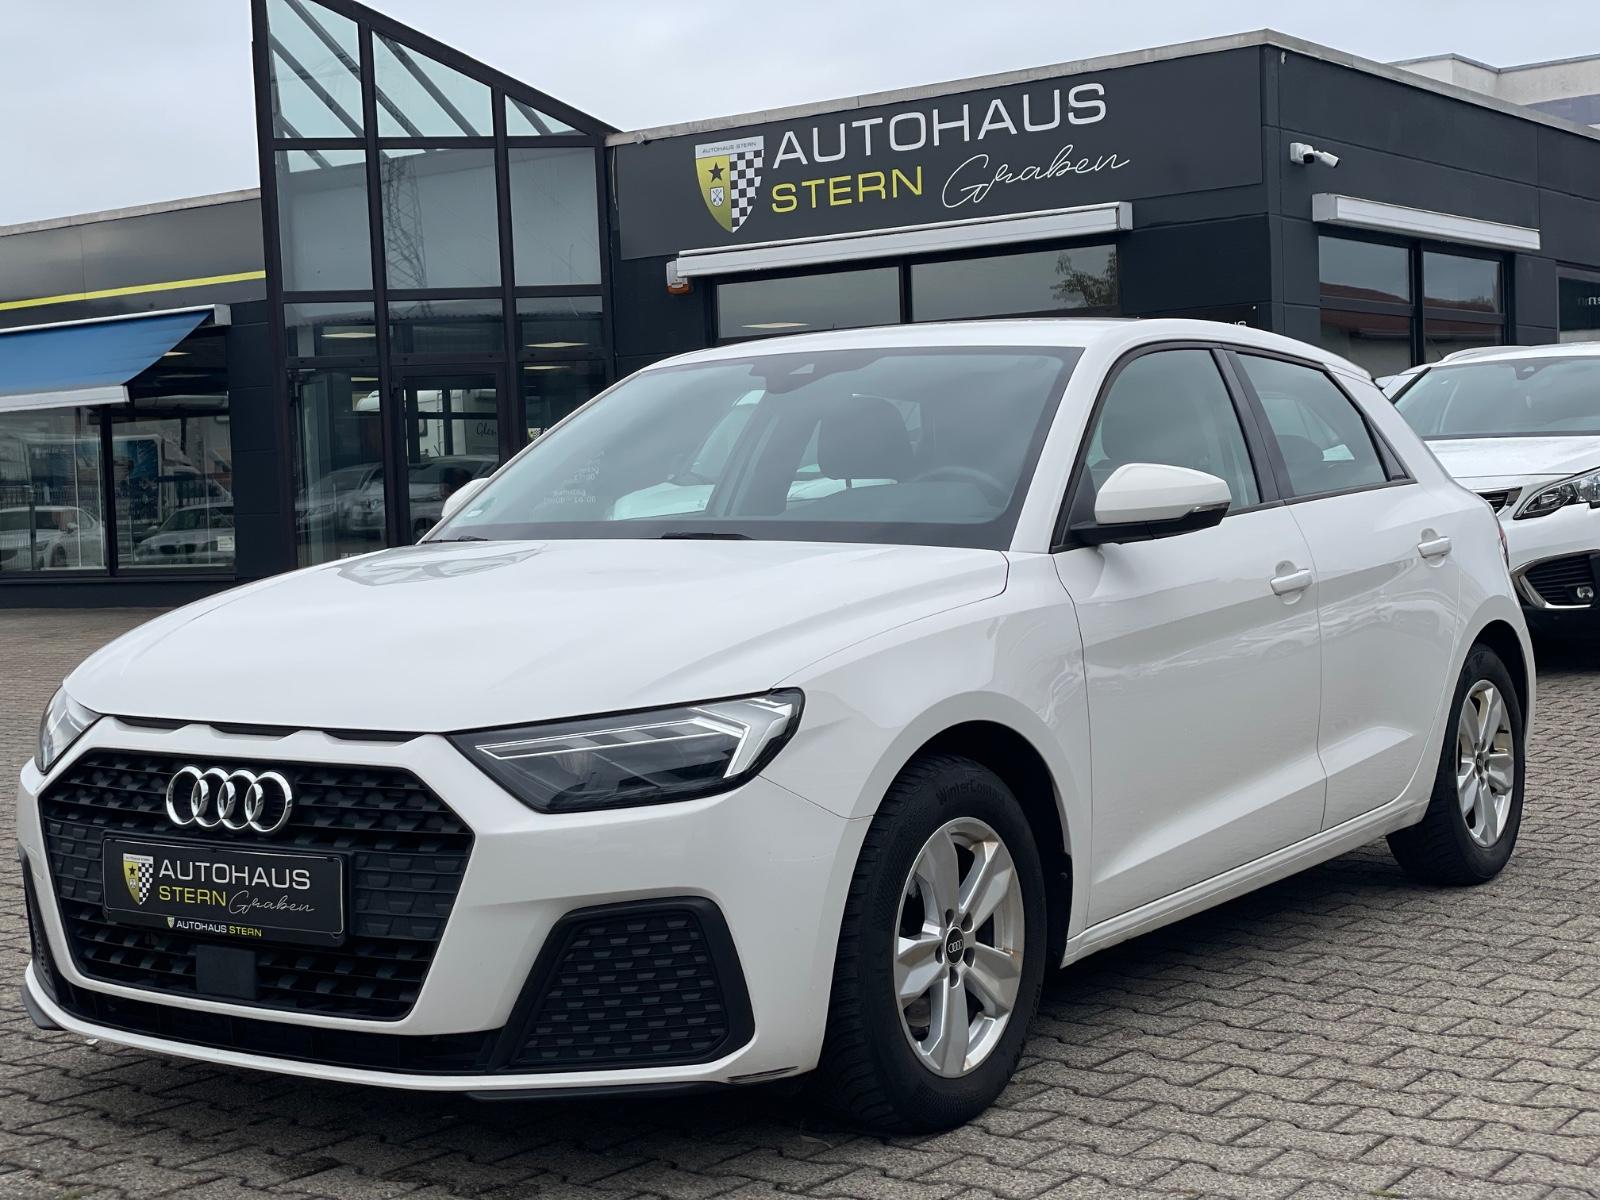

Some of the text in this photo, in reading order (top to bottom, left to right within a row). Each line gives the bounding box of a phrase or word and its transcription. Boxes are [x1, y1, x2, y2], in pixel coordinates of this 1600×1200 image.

[773, 82, 1107, 169] AUTOHAUS
[702, 141, 757, 154] AUTOHAUS STERN
[771, 143, 1130, 213] STERN Graben
[158, 859, 310, 890] AUTOHAUS
[159, 886, 315, 915] STERN Graben
[176, 920, 262, 937] AUTOHAUS STERN
